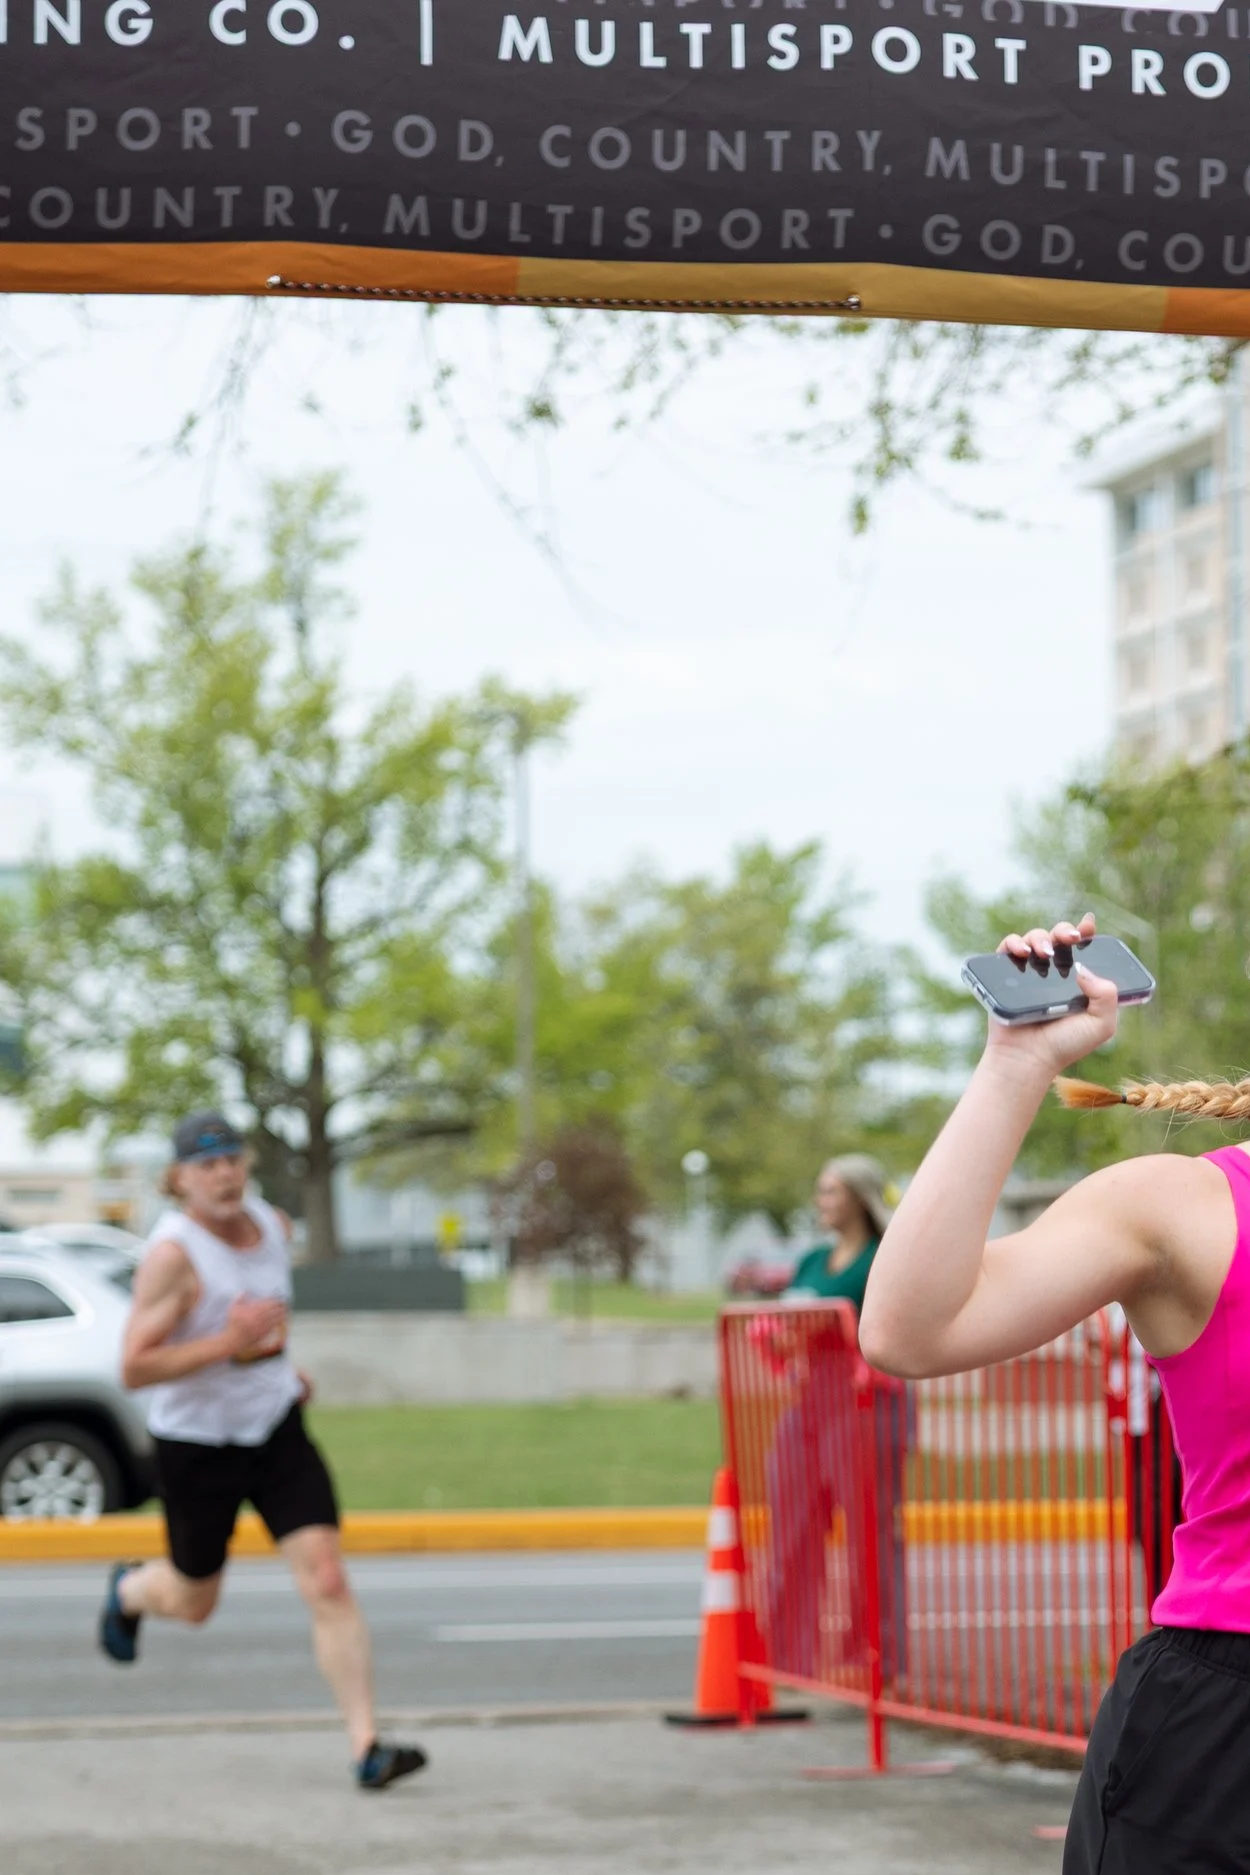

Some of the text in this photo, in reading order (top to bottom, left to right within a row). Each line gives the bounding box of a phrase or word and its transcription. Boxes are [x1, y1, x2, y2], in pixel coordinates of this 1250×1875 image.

[209, 0, 355, 49] CO.
[498, 14, 1027, 84] MULTISPORT
[14, 105, 259, 152] SPORT
[331, 109, 504, 167] GOD,
[539, 124, 892, 176] COUNTRY,
[0, 185, 349, 233] OUNTRY,
[382, 193, 855, 250] MULTISPORT
[922, 213, 1084, 270] GOD,
